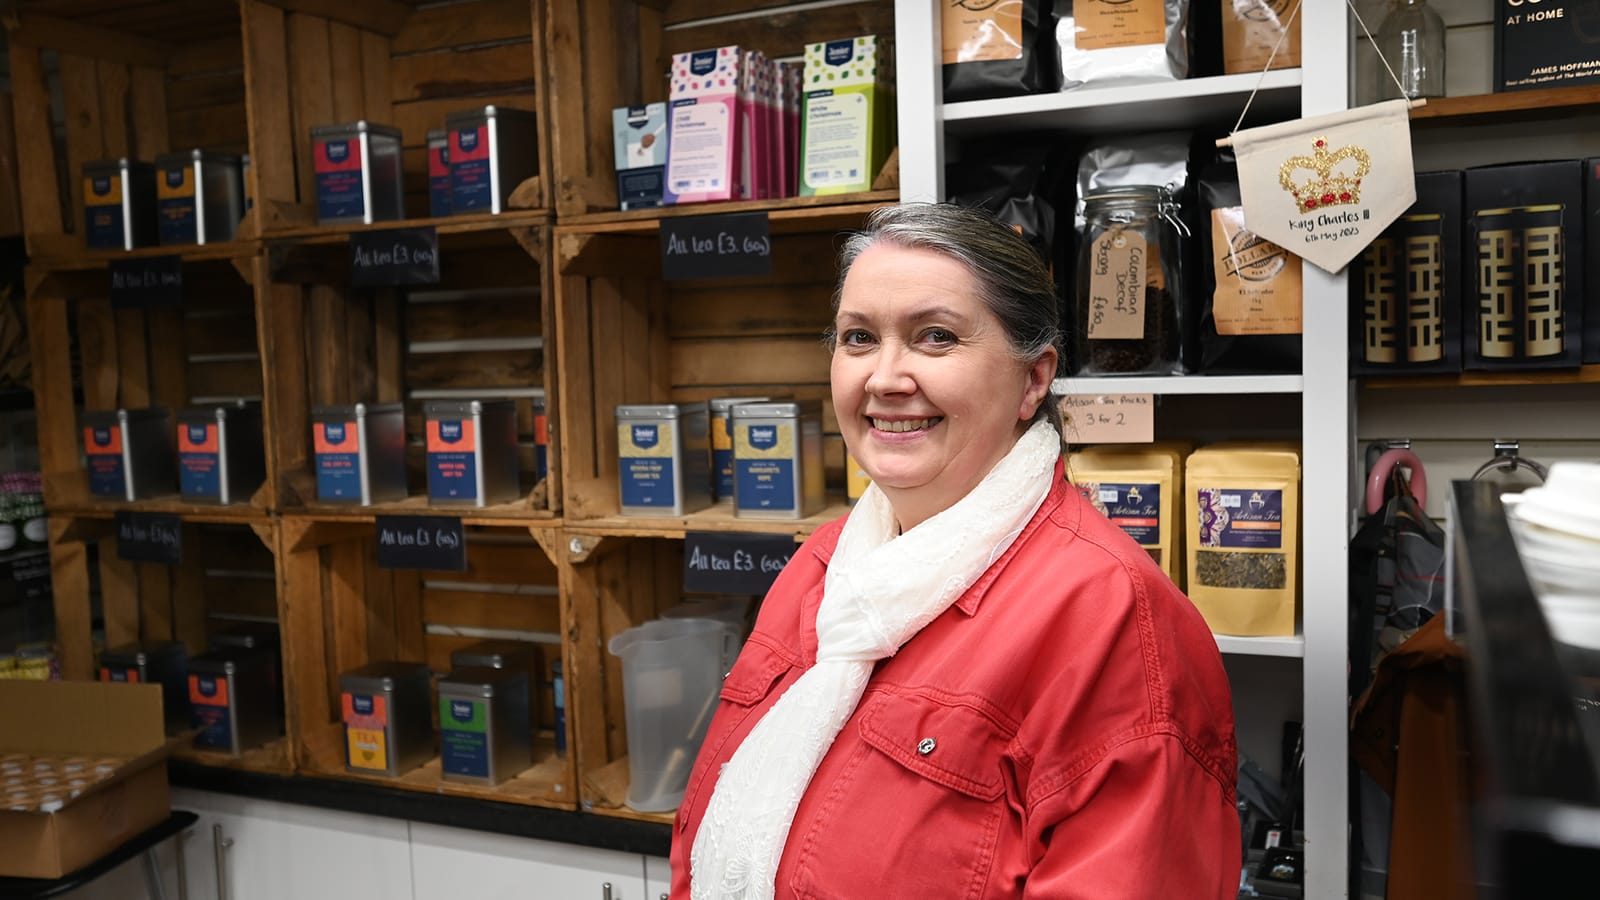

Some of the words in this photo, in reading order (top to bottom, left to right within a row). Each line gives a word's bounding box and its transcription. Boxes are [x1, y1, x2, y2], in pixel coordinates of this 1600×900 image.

[1506, 15, 1521, 26] AT
[1527, 7, 1564, 22] HOME
[1530, 65, 1558, 76] JAMES
[1289, 219, 1315, 232] King
[1318, 211, 1359, 227] Charles
[1320, 232, 1338, 242] May
[1339, 227, 1360, 237] 2023
[667, 232, 689, 255] All
[692, 236, 714, 254] tea
[1095, 239, 1112, 275] Strong
[1113, 271, 1128, 313] Decaf
[1066, 396, 1095, 407] Artisan
[1086, 413, 1095, 426] 3
[1098, 413, 1112, 424] for
[1116, 412, 1127, 425] 2
[1141, 505, 1157, 516] Tea
[1264, 510, 1280, 520] Tea
[688, 545, 710, 571] All
[711, 553, 731, 571] tea
